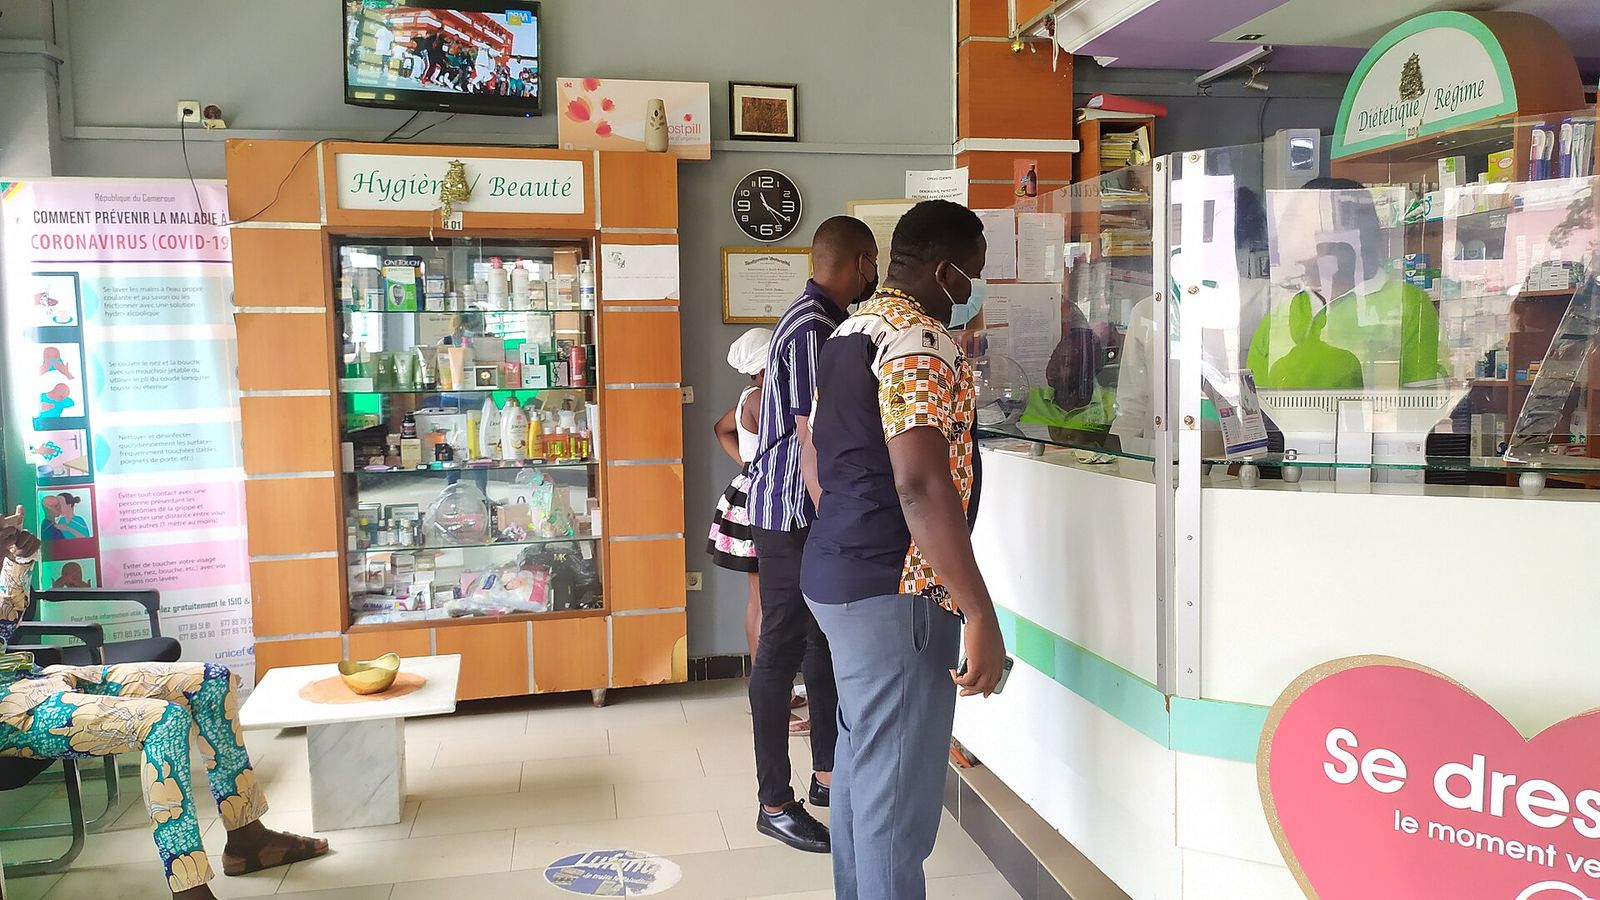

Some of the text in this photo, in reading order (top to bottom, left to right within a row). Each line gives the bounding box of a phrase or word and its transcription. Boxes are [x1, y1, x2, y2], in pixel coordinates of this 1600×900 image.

[1358, 100, 1419, 131] Diététique
[1434, 80, 1484, 112] Régime
[668, 123, 700, 136] ostpill
[489, 176, 572, 197] Beauté
[758, 177, 774, 188] 12
[95, 193, 130, 203] République
[133, 194, 141, 202] du
[737, 200, 750, 211] 9
[782, 201, 795, 212] 3
[33, 210, 91, 224] COMMENT
[96, 209, 150, 224] PRÉVENIR
[154, 212, 166, 224] LA
[170, 212, 217, 225] MALADIE
[760, 224, 773, 235] 6
[32, 234, 147, 250] CORONAVIRUS
[173, 601, 218, 613] gratuitement
[215, 647, 246, 659] unicef
[1322, 727, 1408, 793] Se
[1394, 809, 1419, 834] le
[1428, 820, 1556, 867] moment
